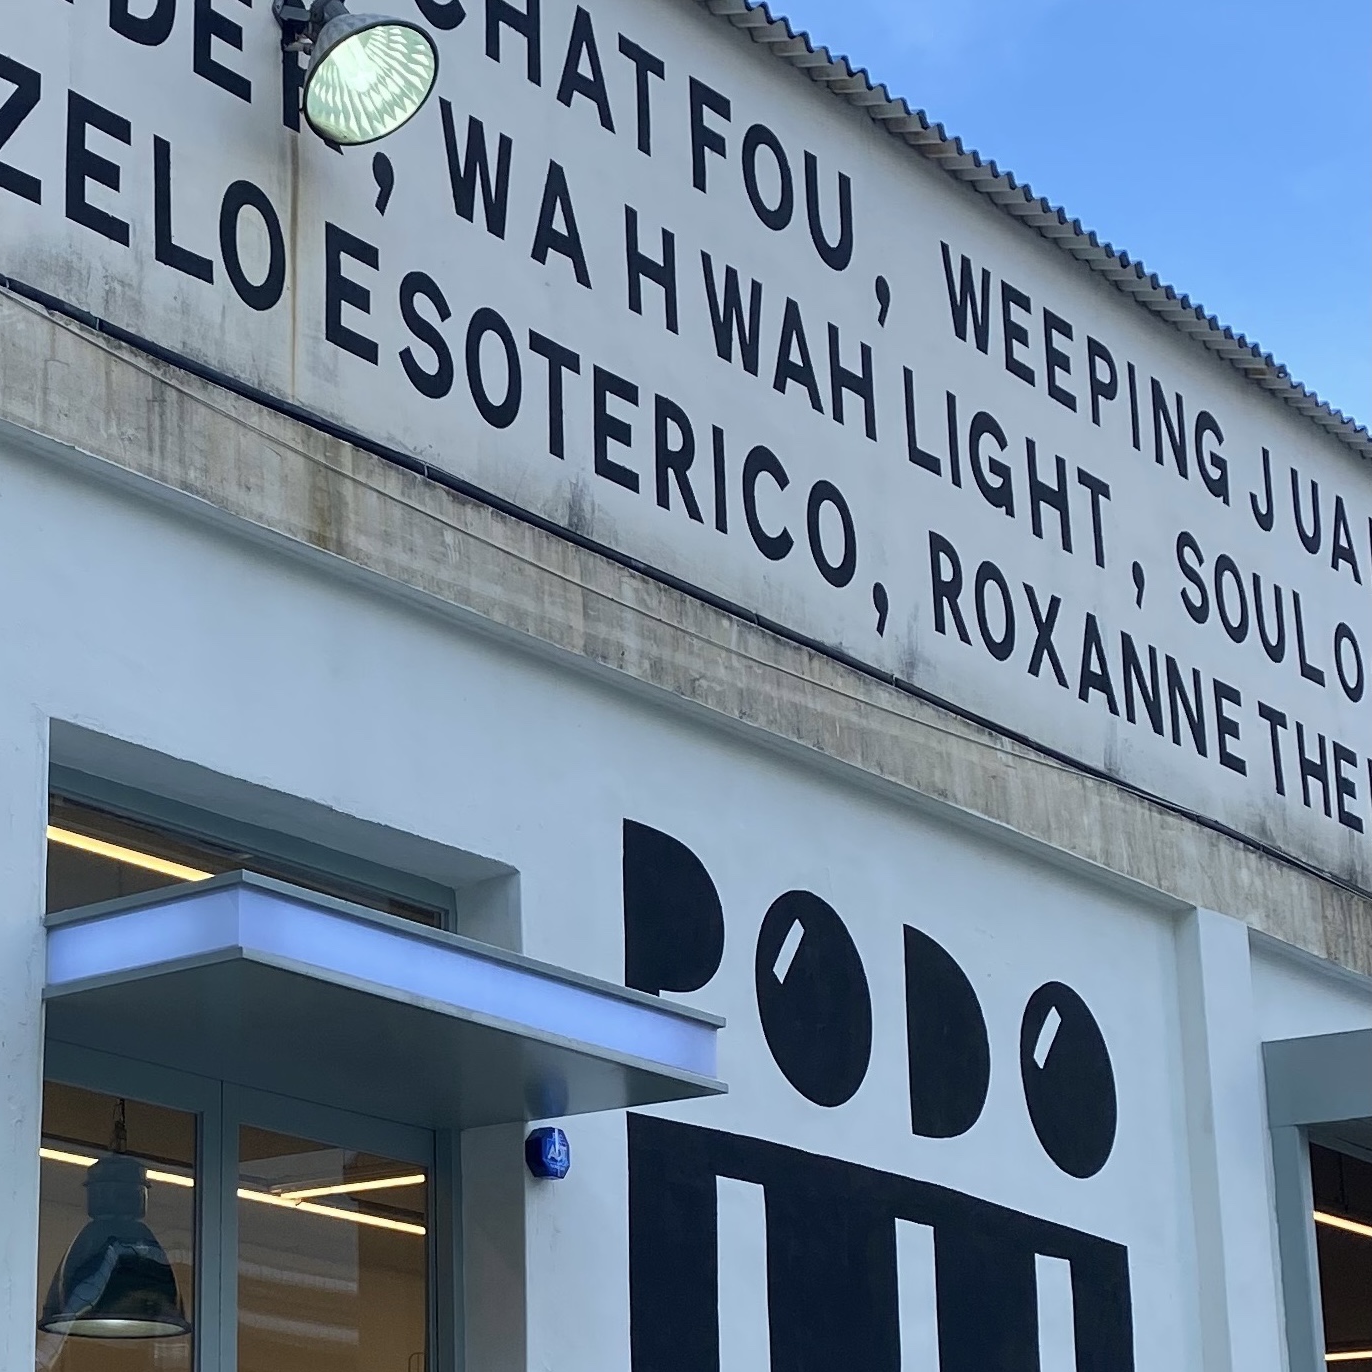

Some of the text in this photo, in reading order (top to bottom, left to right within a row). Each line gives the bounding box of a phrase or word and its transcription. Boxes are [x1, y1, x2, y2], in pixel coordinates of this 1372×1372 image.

[940, 241, 1229, 506] WEEPING
[1250, 447, 1372, 590] JUA
[929, 531, 1247, 777] ROXANNE
[623, 818, 1118, 1179] PODO
